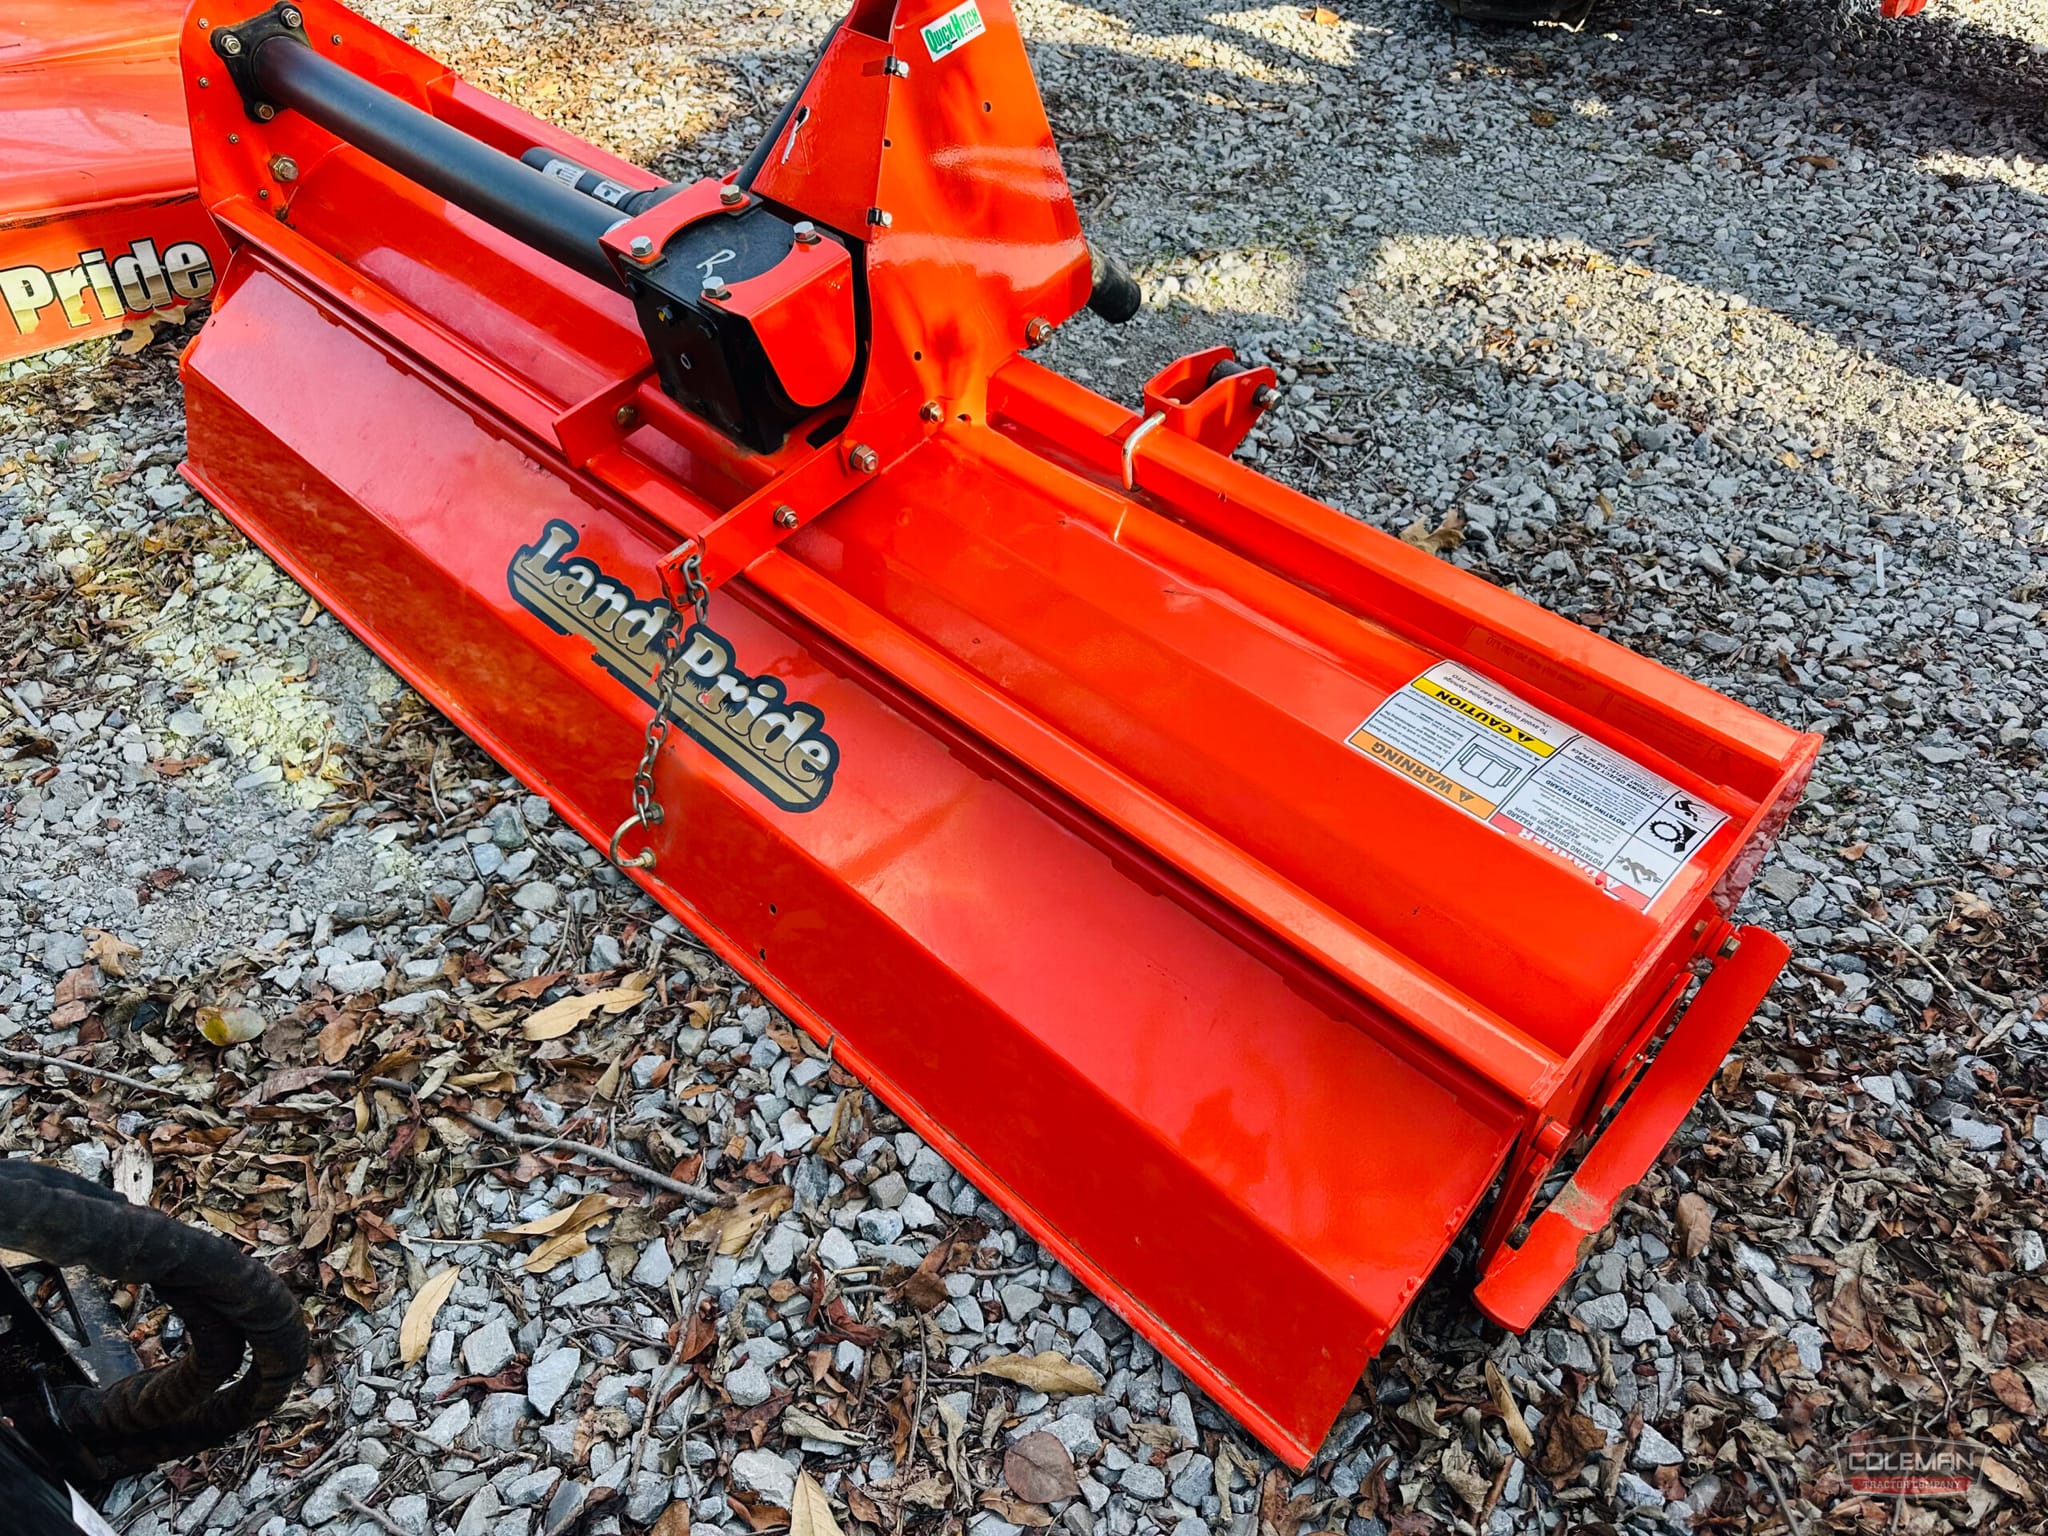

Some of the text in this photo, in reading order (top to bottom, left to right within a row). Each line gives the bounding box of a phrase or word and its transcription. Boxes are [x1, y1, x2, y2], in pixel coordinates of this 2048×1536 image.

[0, 238, 216, 335] Pride
[521, 527, 831, 783] Land Pride
[1435, 689, 1513, 735] CAUTION
[1368, 741, 1456, 793] WARNING
[1573, 754, 1654, 799] THROWN OBJECT HAZARD
[1544, 779, 1626, 826] ROTATING PARTS HAZARD
[1504, 809, 1603, 866] ROTATING DRIVELINE HAZARD
[1562, 827, 1580, 838] KEEP
